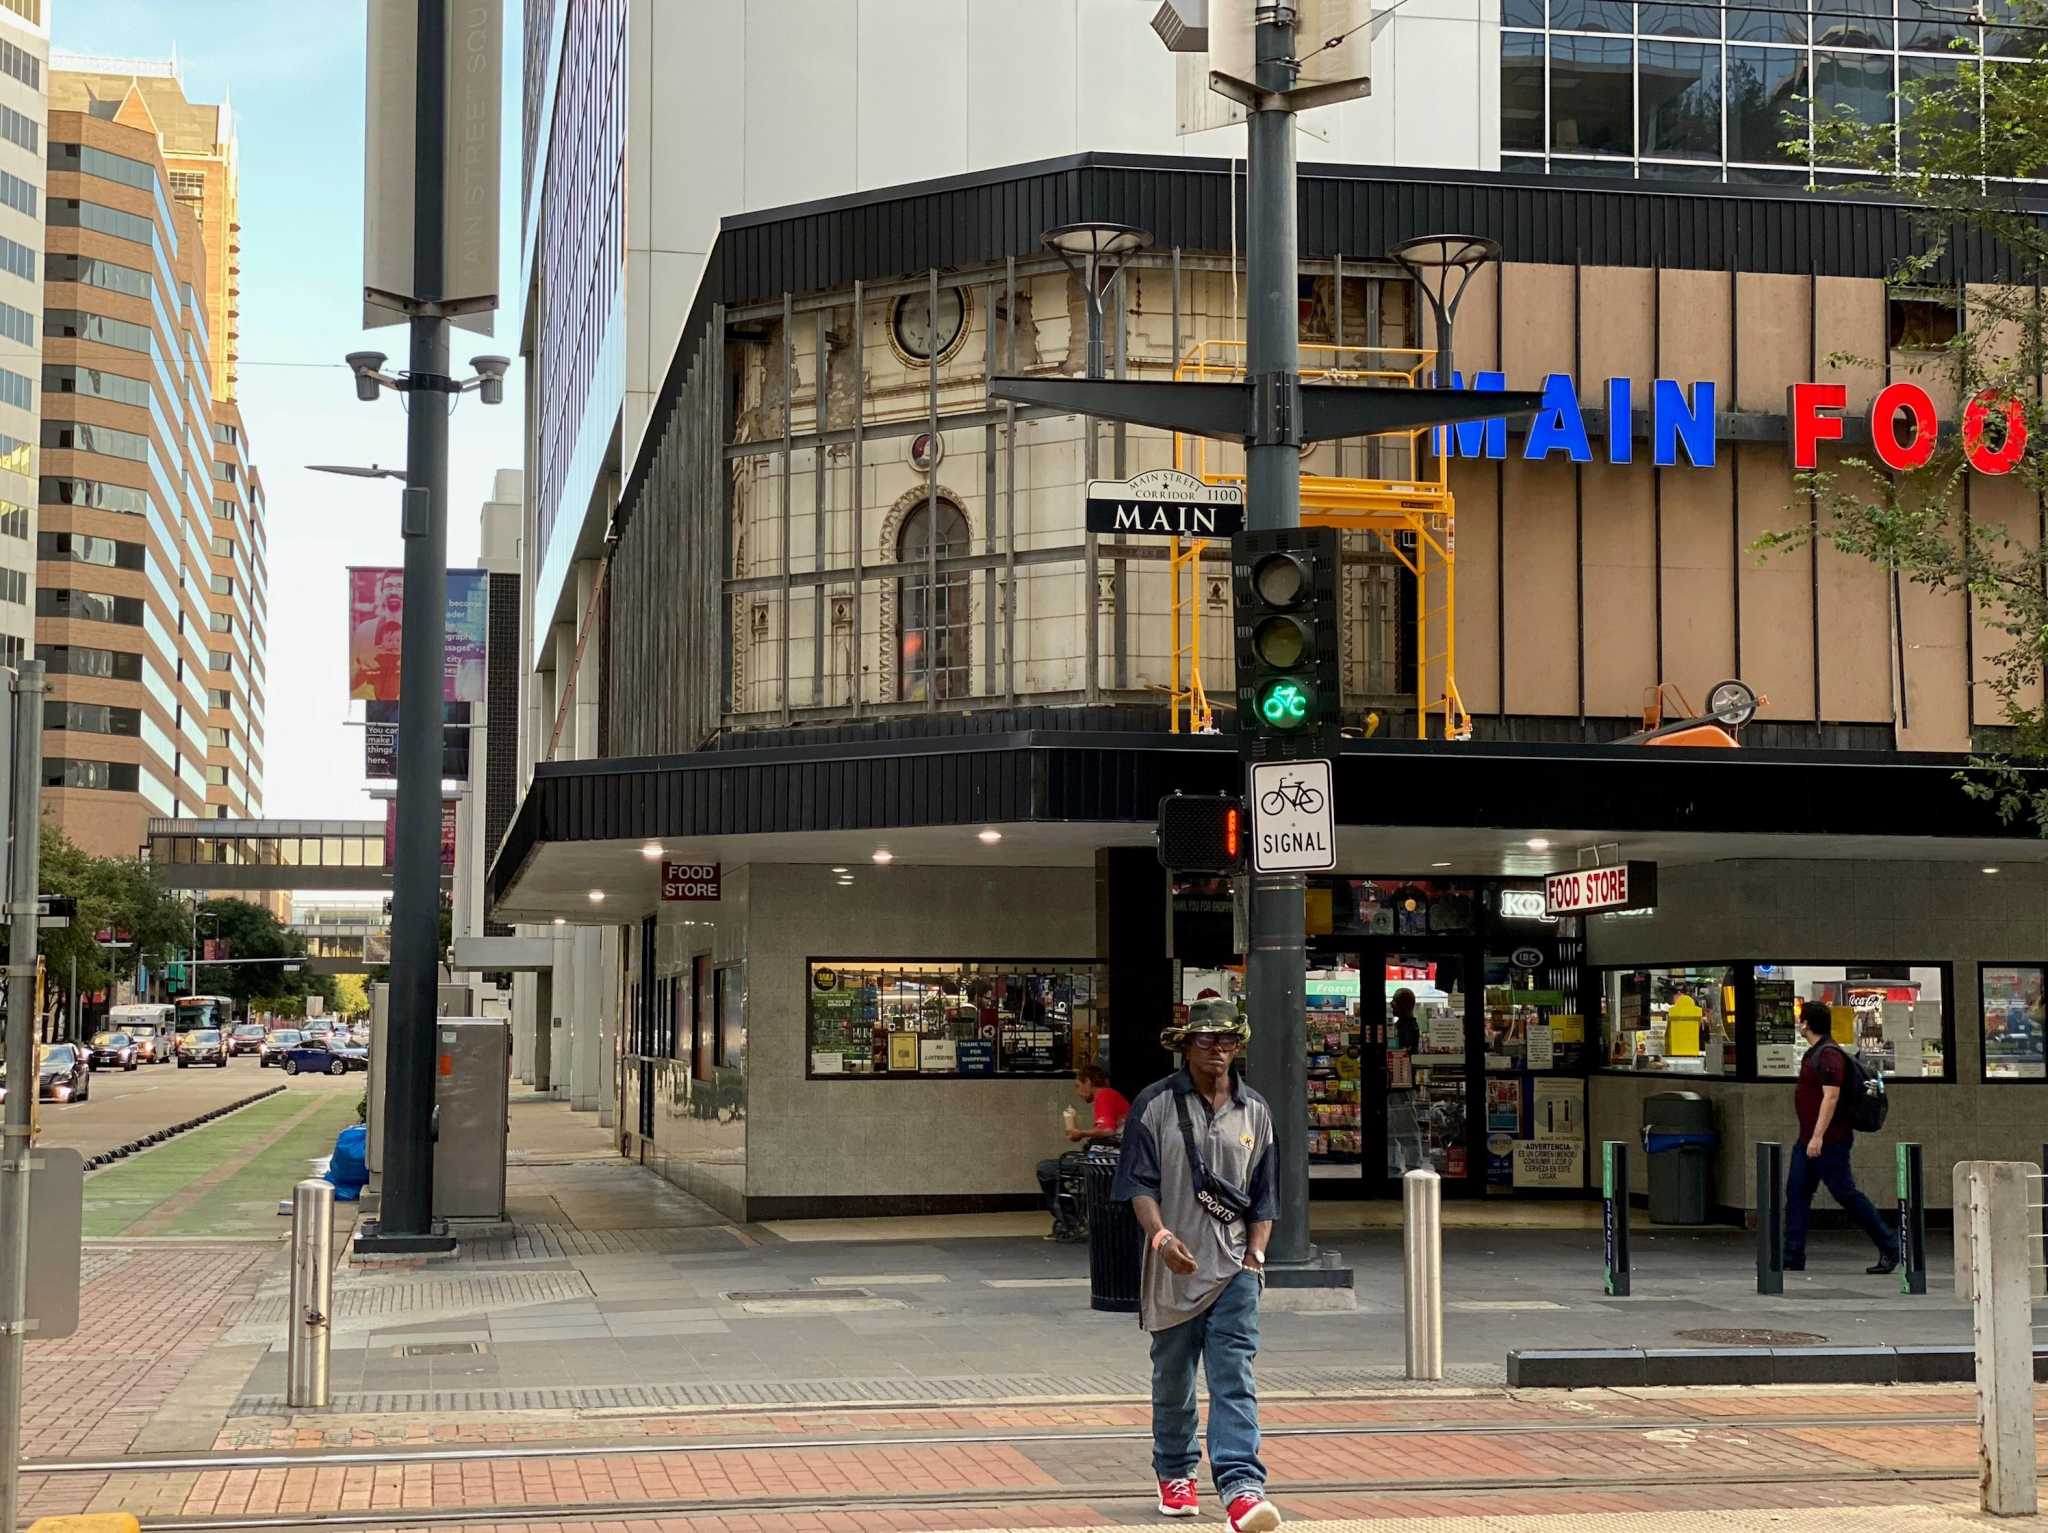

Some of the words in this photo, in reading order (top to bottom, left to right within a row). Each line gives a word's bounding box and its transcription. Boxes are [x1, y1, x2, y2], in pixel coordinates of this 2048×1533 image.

[1431, 370, 1716, 468] MAIN
[1130, 473, 1159, 490] MAIN
[1163, 472, 1202, 493] STREET
[1135, 489, 1196, 501] CORRIDOR
[1208, 489, 1238, 502] 1100
[1113, 503, 1217, 533] MAIN
[368, 726, 384, 734] You
[368, 735, 391, 744] make
[368, 745, 393, 755] things
[1263, 831, 1327, 854] SIGNAL
[668, 866, 714, 879] FOOD
[665, 883, 718, 896] STORE
[1548, 876, 1580, 909] FOOD
[1586, 868, 1626, 905] STORE
[1198, 1191, 1236, 1221] SPORTS
